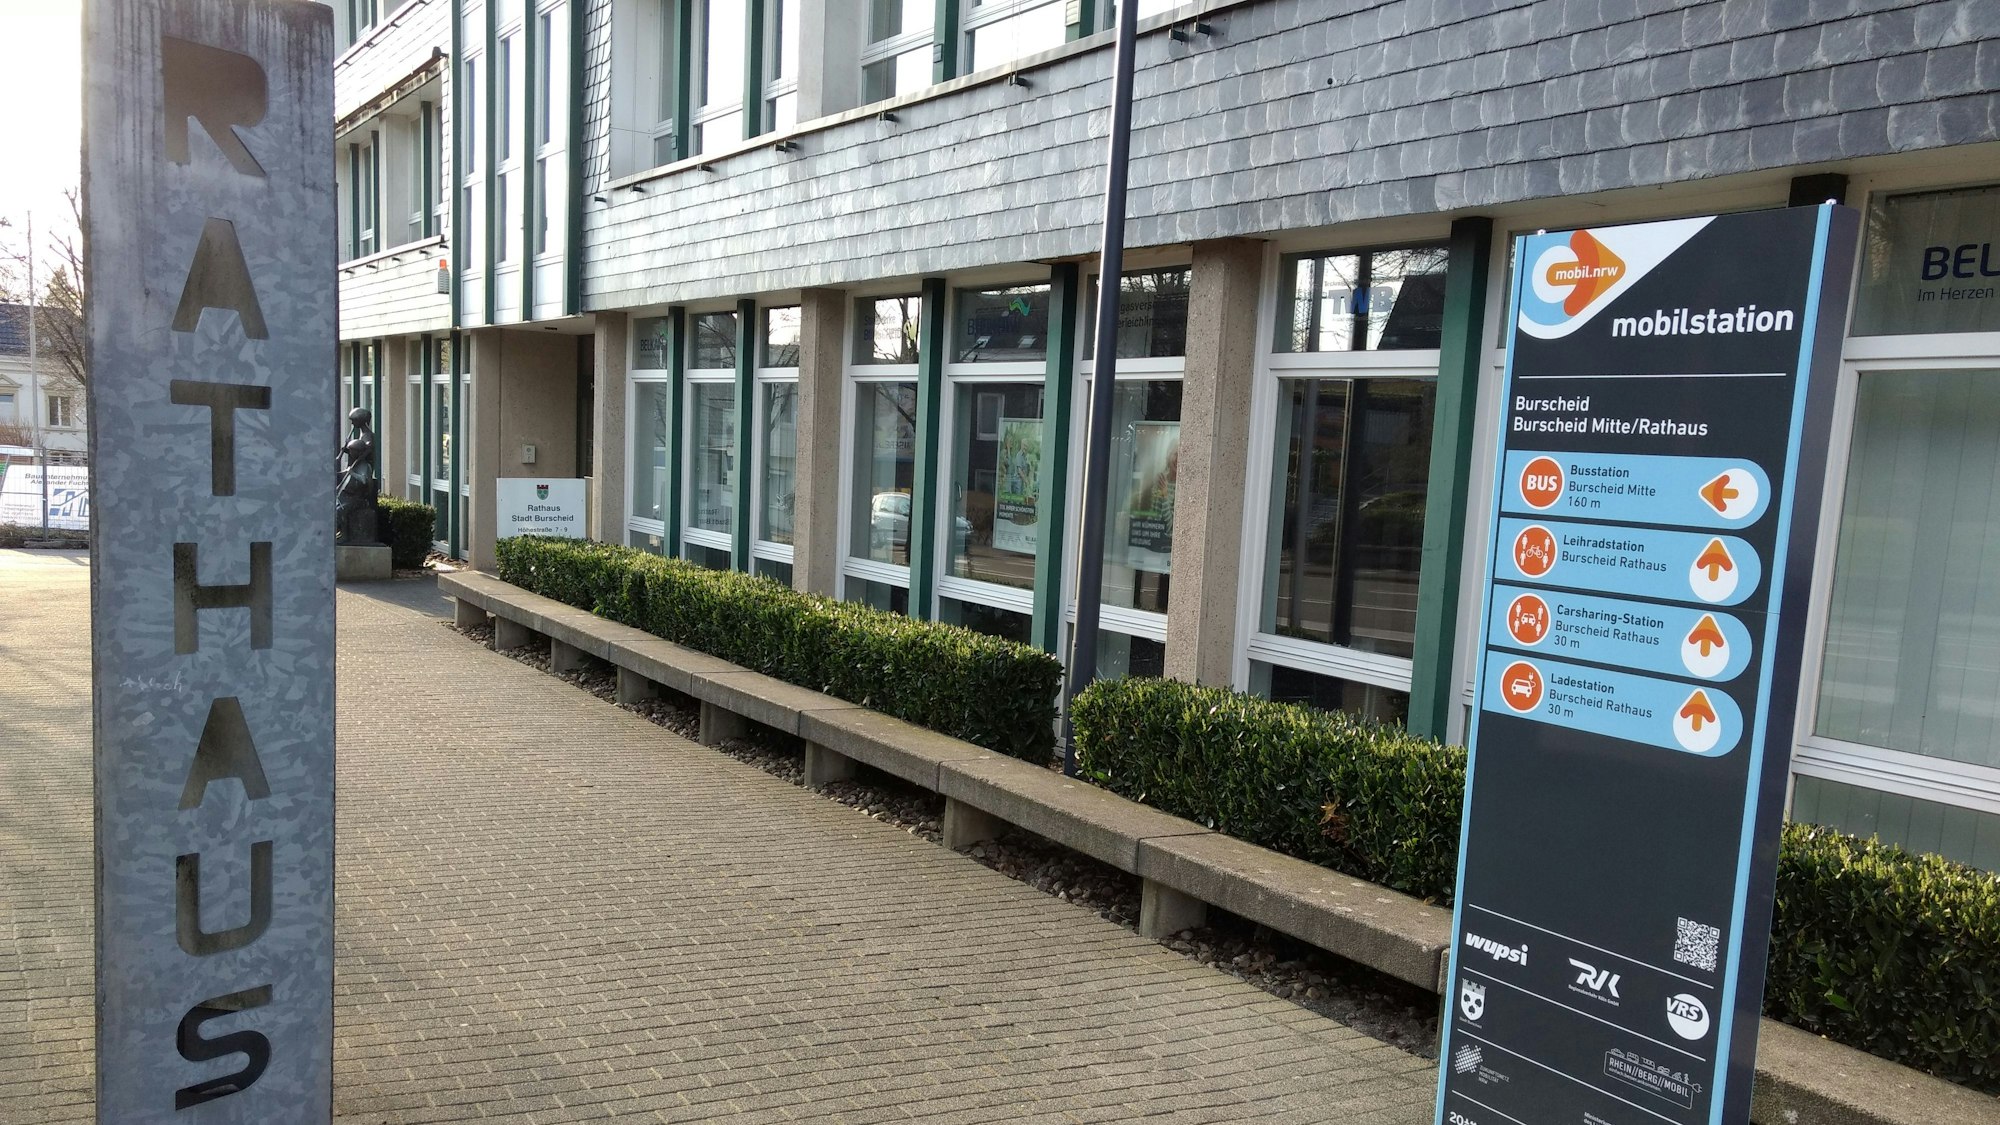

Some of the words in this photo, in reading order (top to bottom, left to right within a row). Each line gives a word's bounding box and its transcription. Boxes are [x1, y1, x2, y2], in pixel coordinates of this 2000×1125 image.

[1555, 264, 1618, 281] mobil.nrw
[1917, 289, 1935, 301] Im
[1940, 287, 1994, 300] Herzen
[1612, 304, 1794, 337] mobilstation
[1515, 396, 1590, 412] Burscheid
[1513, 417, 1587, 433] Burscheid
[1591, 418, 1708, 436] Mitte/Rathaus
[1570, 465, 1630, 478] Busstation
[1526, 474, 1558, 492] BUS
[1569, 481, 1624, 495] Burscheid
[1627, 484, 1656, 497] Mitte
[527, 504, 561, 512] Rathaus
[1568, 496, 1587, 508] 160
[1590, 500, 1601, 509] m
[511, 514, 532, 522] Stadt
[534, 514, 574, 522] Burscheid
[1563, 535, 1645, 552] Leihradstation
[1561, 551, 1616, 567] Burscheid
[1619, 557, 1667, 572] Rathaus
[162, 35, 273, 1111] RATHAUS
[1557, 604, 1664, 629] Carsharing-Station
[1554, 635, 1567, 647] 30
[1570, 638, 1580, 648] m
[1555, 620, 1609, 638] Burscheid
[1612, 629, 1660, 646] Rathaus
[1551, 673, 1615, 694] Ladestation
[1548, 703, 1560, 715] 30
[1563, 707, 1574, 718] m
[1549, 689, 1603, 709] Burscheid
[1606, 699, 1652, 718] Rathaus
[1465, 932, 1529, 966] wupsi
[1666, 997, 1700, 1020] VRS
[1609, 1057, 1689, 1098] RHEIN//BERG//MOBIL
